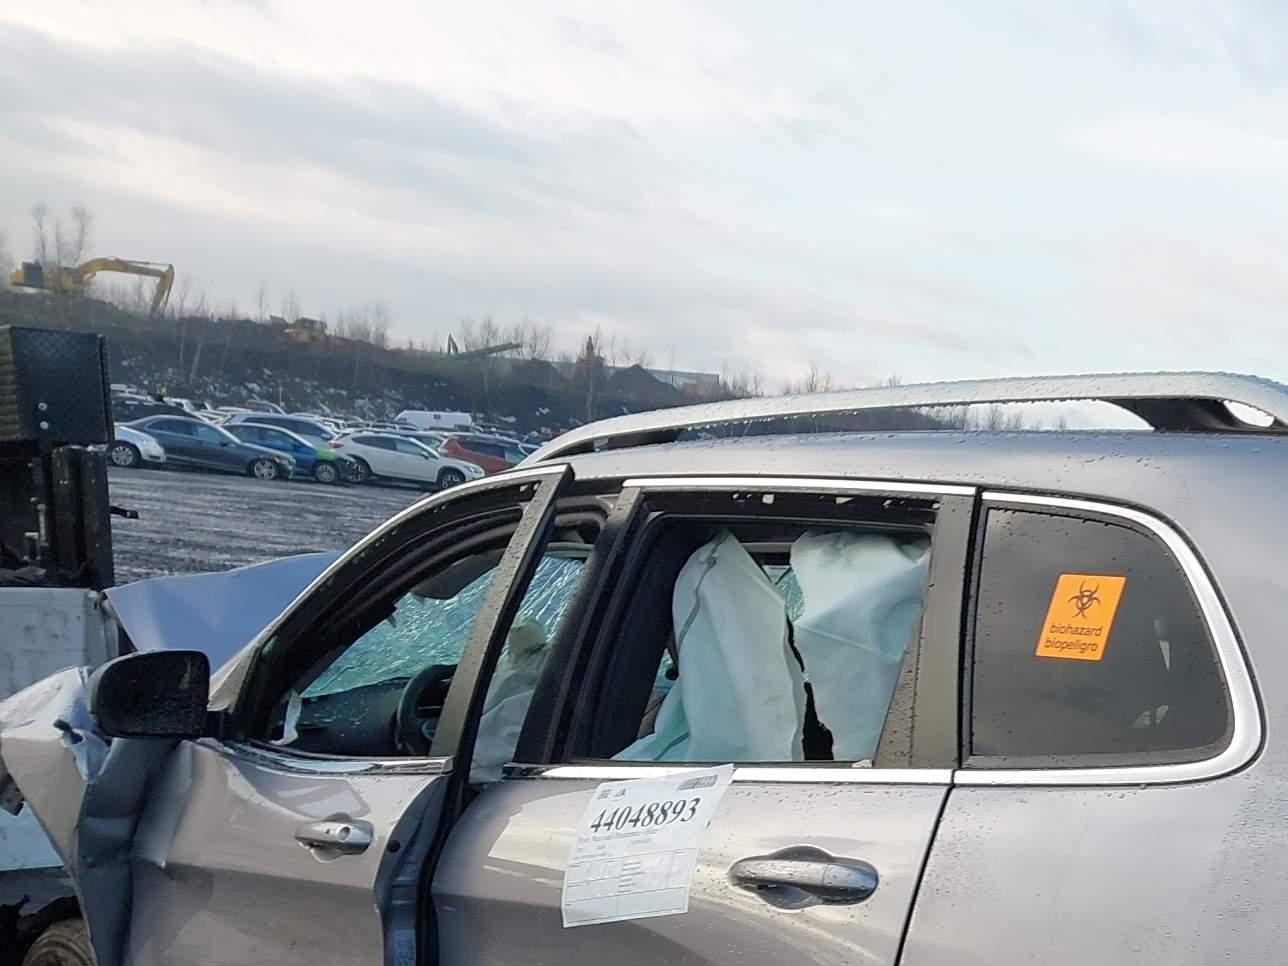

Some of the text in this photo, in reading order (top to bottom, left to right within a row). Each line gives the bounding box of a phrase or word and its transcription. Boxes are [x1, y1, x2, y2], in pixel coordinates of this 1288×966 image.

[1049, 622, 1104, 637] biohazard
[1044, 637, 1099, 654] biopeligro
[590, 797, 701, 833] 44048893
